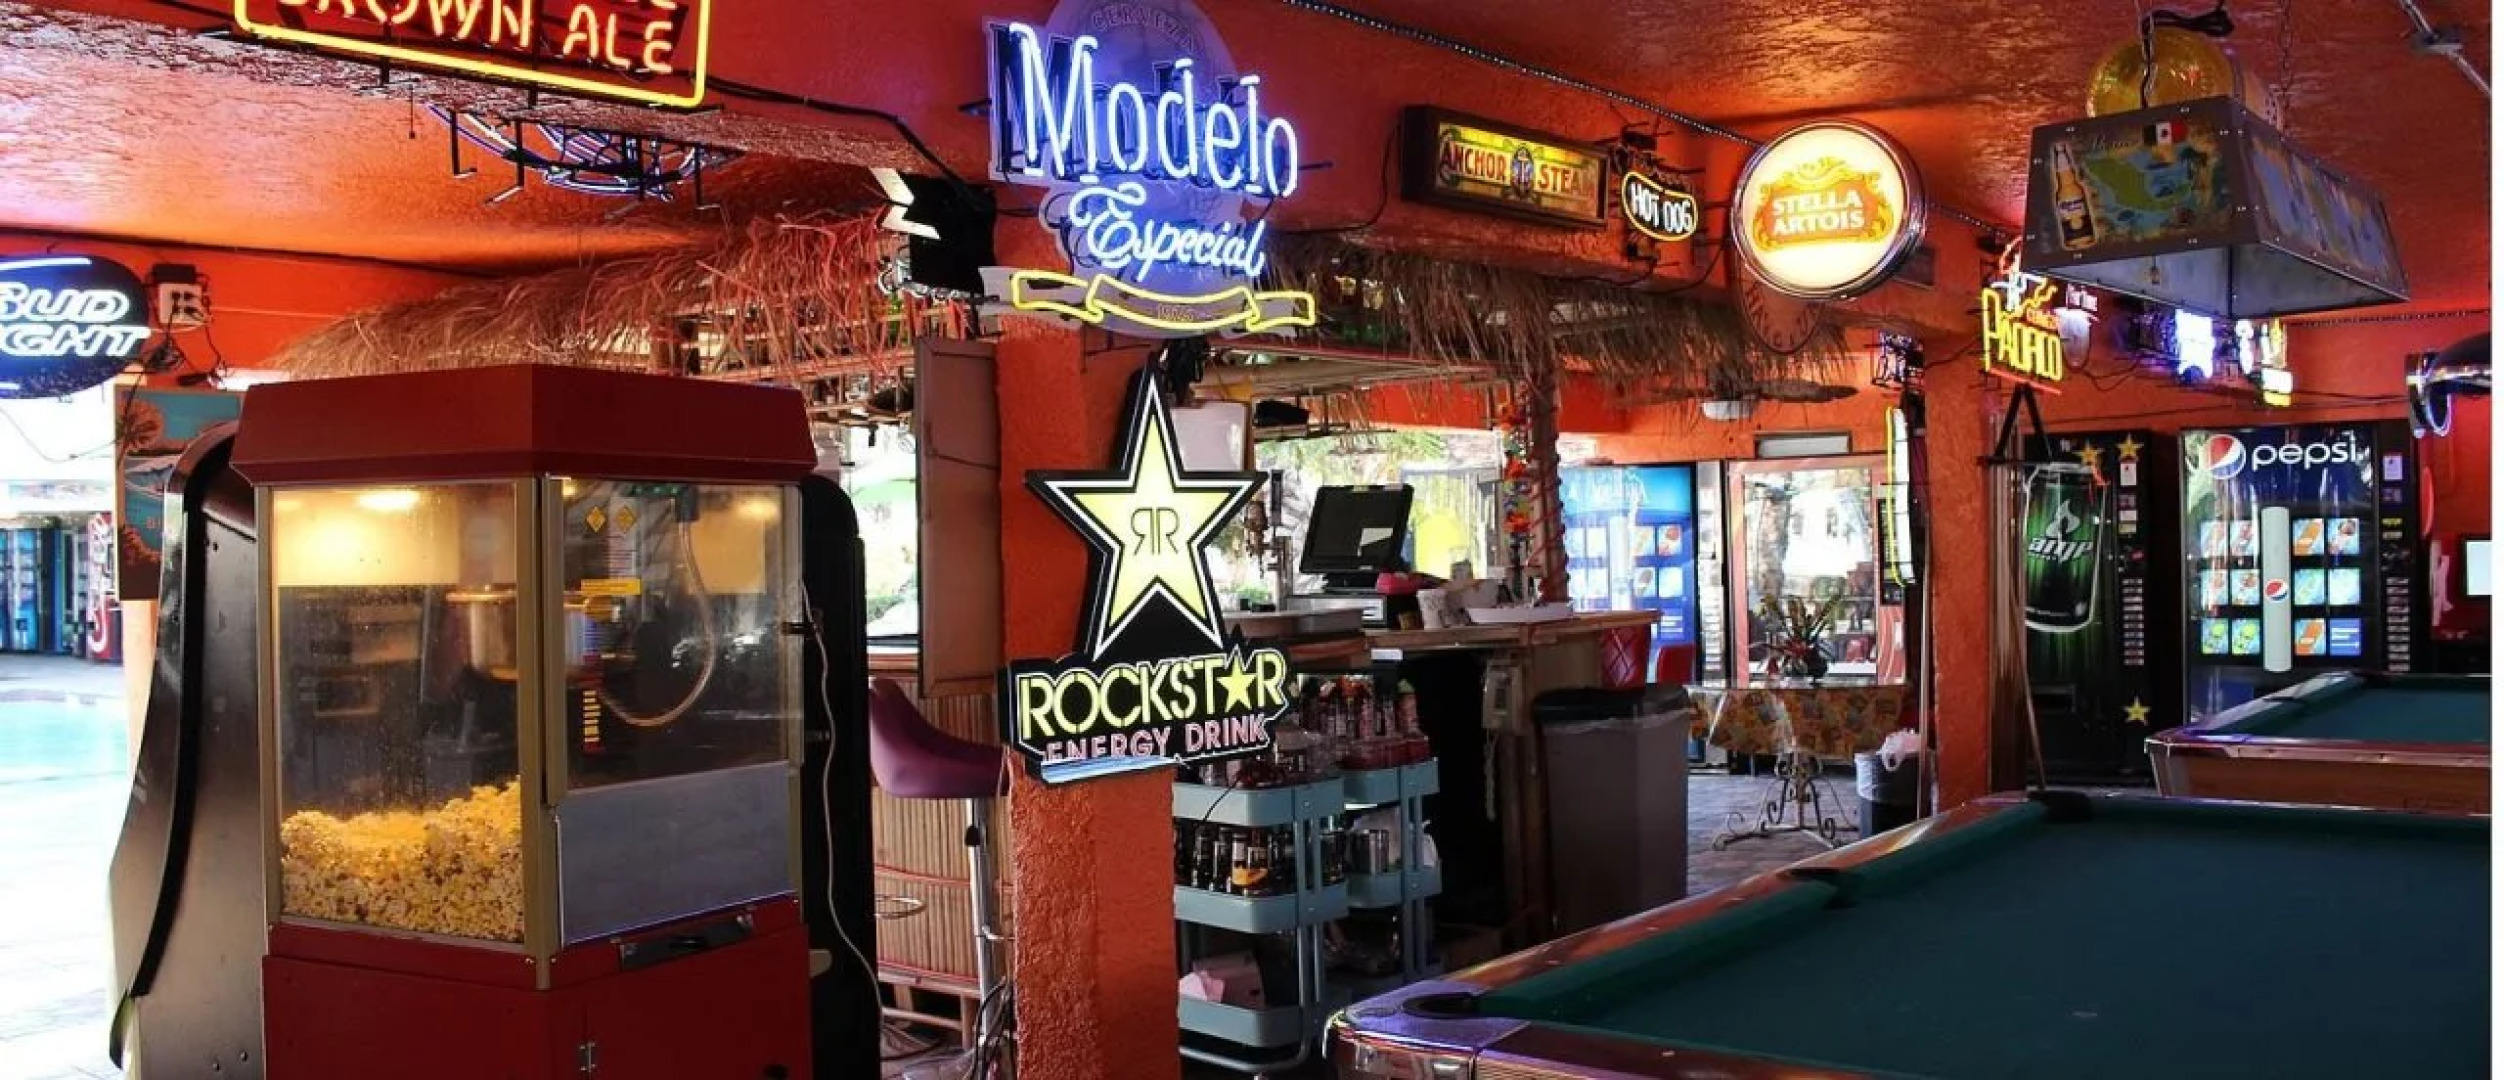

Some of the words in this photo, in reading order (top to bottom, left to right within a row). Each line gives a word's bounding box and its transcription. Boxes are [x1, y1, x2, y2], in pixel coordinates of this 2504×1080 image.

[563, 4, 674, 74] ALE
[1009, 22, 1299, 197] Modelo
[1439, 137, 1507, 182] ANCHOR
[1630, 182, 1660, 227] HOT
[1663, 199, 1697, 234] DOG
[1771, 188, 1863, 216] STELLA
[1773, 208, 1865, 236] ARTOIS
[1069, 182, 1266, 283] Especial
[0, 281, 130, 323] BUD
[0, 323, 151, 357] GHT
[1981, 287, 2063, 383] PACIFICO
[2251, 430, 2356, 473] pepsi
[1045, 726, 1171, 763] ENERGY
[1184, 713, 1268, 753] DRINK
